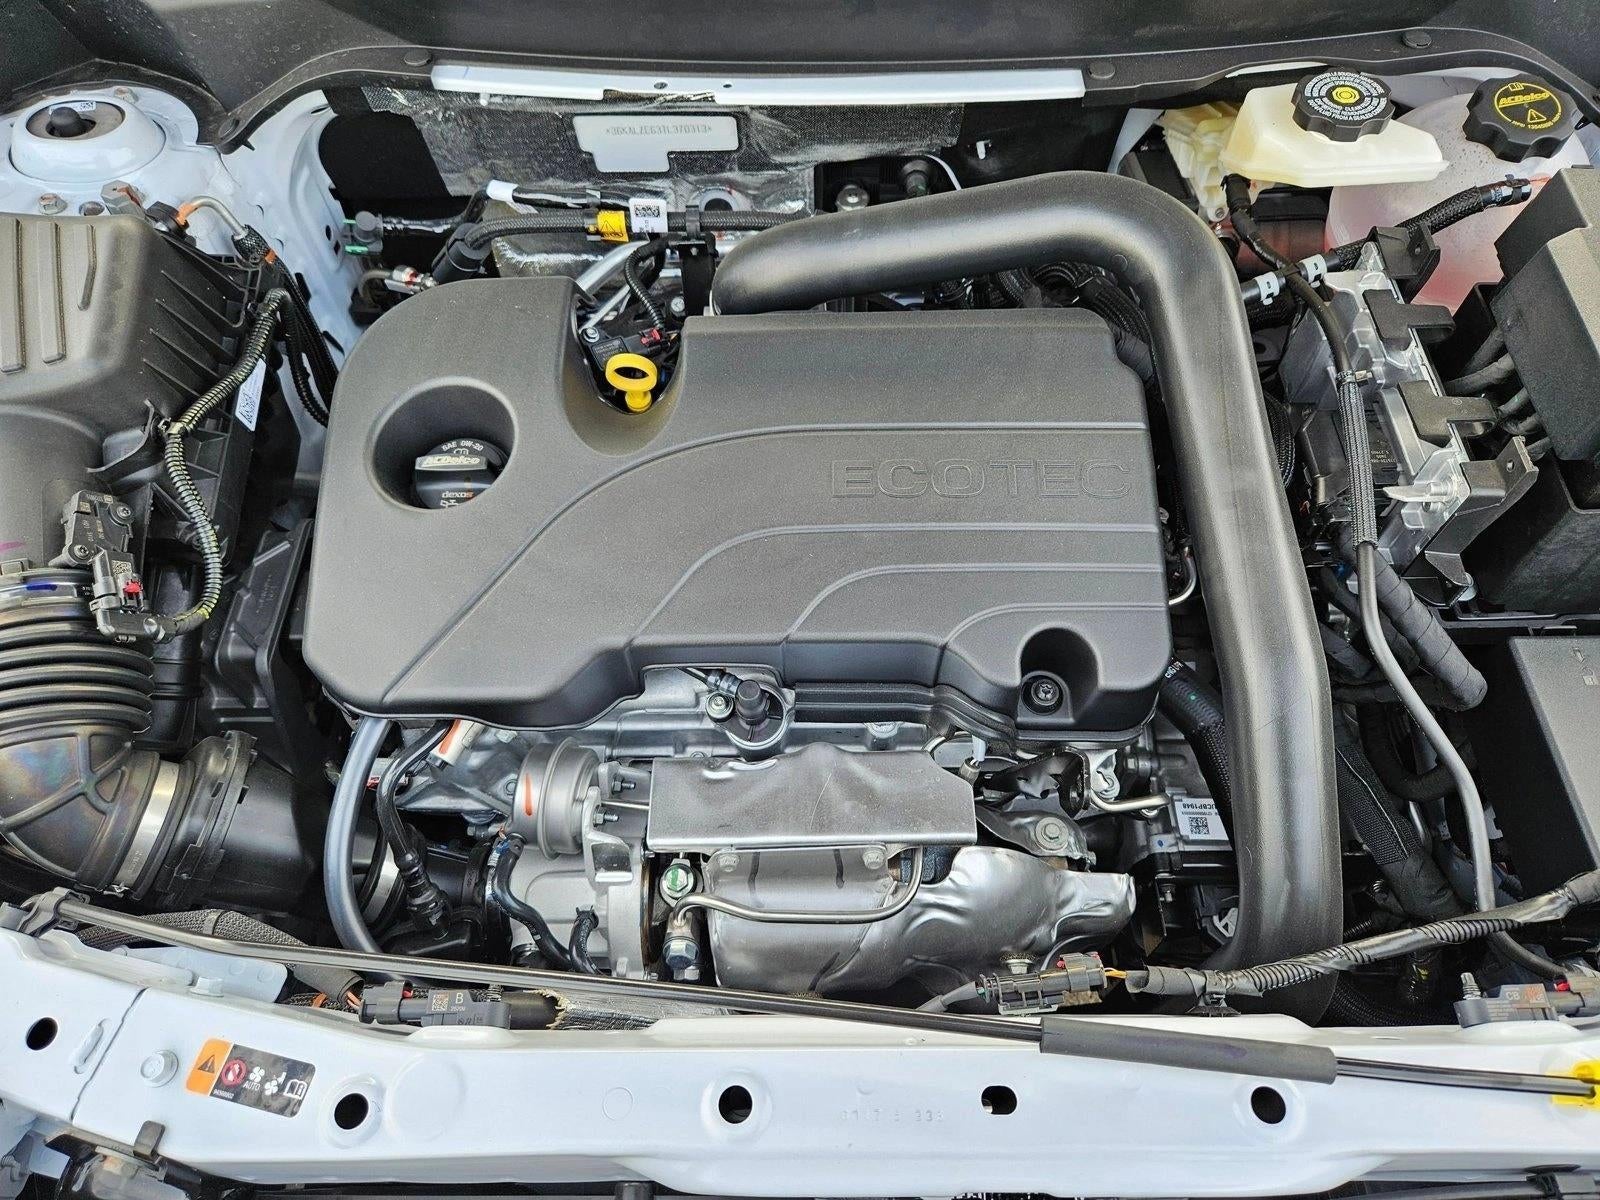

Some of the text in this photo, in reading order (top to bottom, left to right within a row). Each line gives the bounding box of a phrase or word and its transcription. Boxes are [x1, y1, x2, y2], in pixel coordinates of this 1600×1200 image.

[442, 441, 457, 451] SAE
[421, 456, 480, 467] ACDelco
[831, 459, 1131, 499] ECOTEC
[442, 490, 474, 499] dexos
[456, 992, 464, 1004] B
[243, 1081, 260, 1091] AUTO
